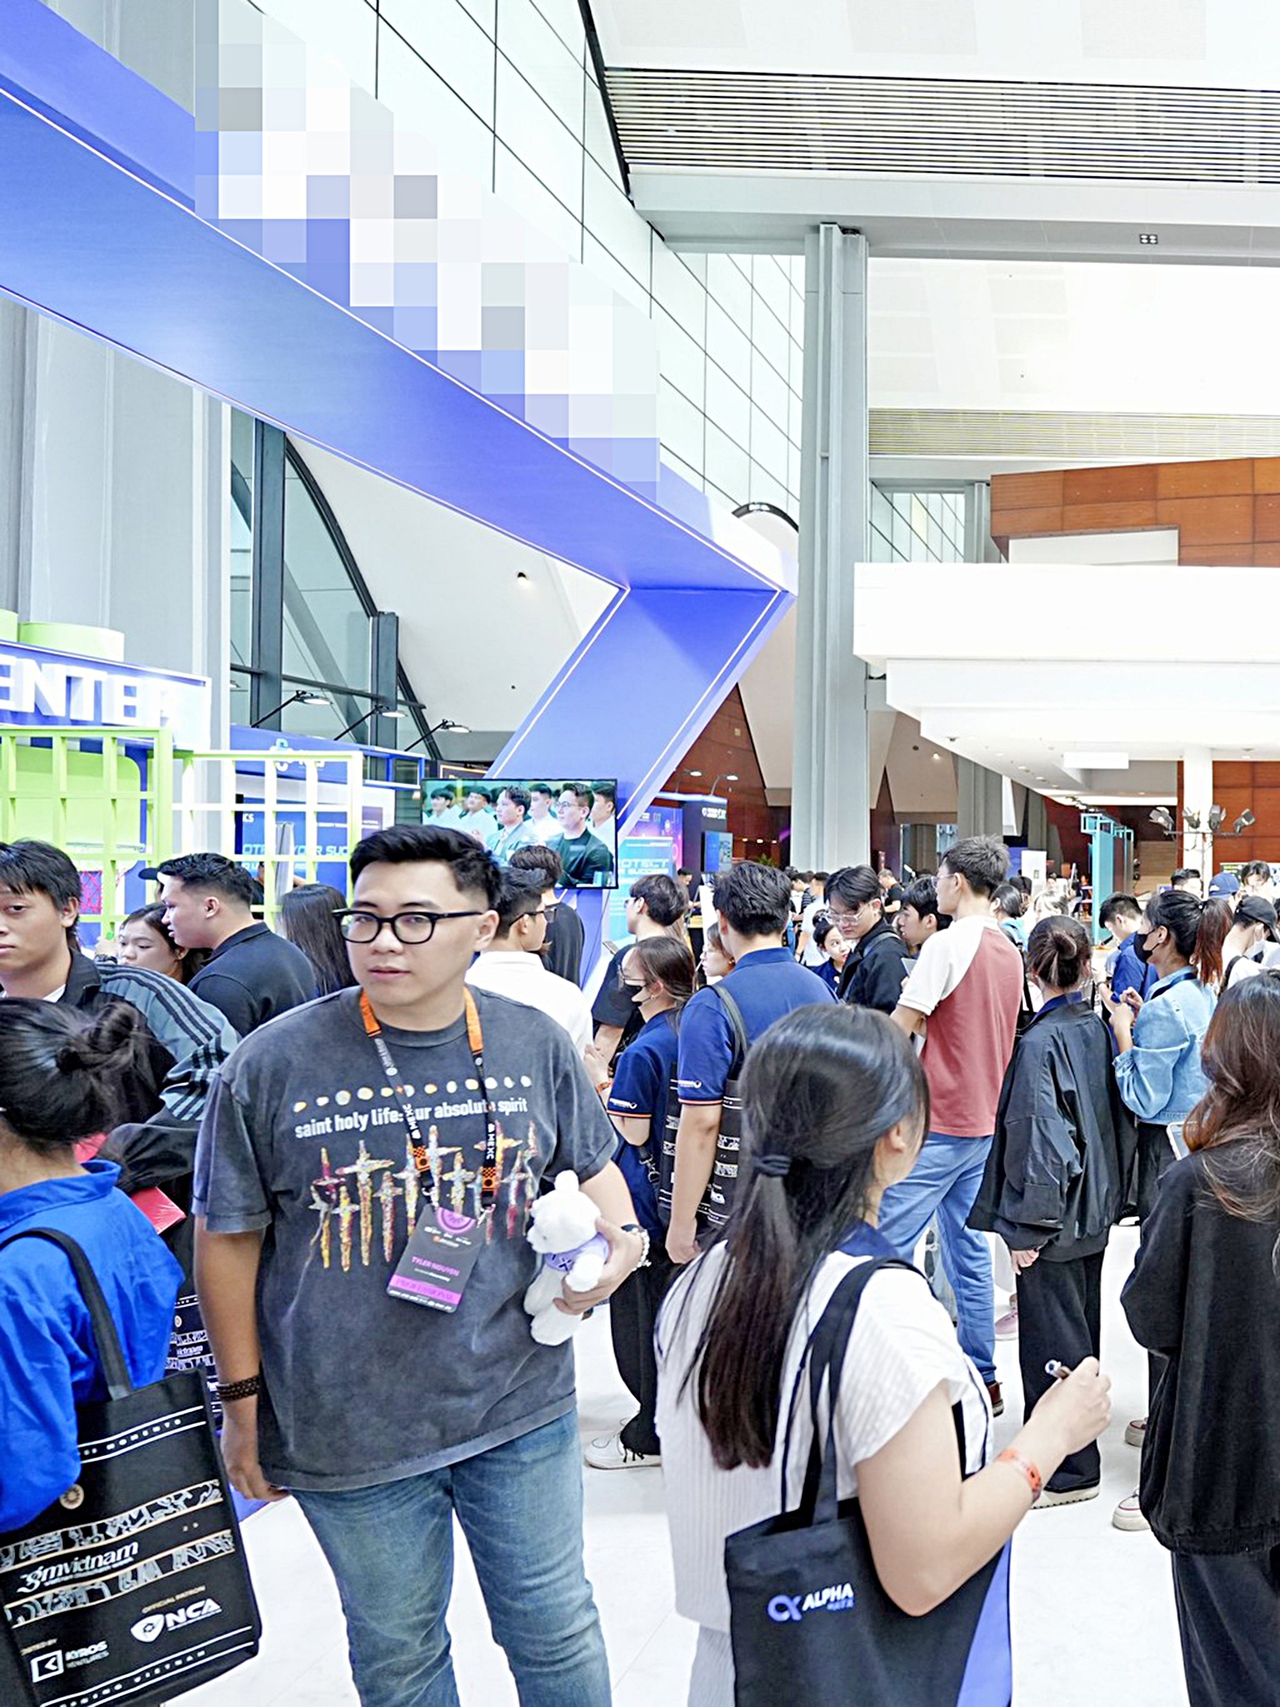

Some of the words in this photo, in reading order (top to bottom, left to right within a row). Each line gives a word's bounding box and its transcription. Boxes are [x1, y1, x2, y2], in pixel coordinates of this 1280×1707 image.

[295, 1118, 332, 1139] saint
[335, 1113, 369, 1132] holy
[415, 1106, 432, 1121] ur
[498, 1098, 528, 1113] spirit
[802, 1583, 854, 1611] ALPHA
[167, 1598, 222, 1627] NCA
[65, 1640, 108, 1661] KYROS
